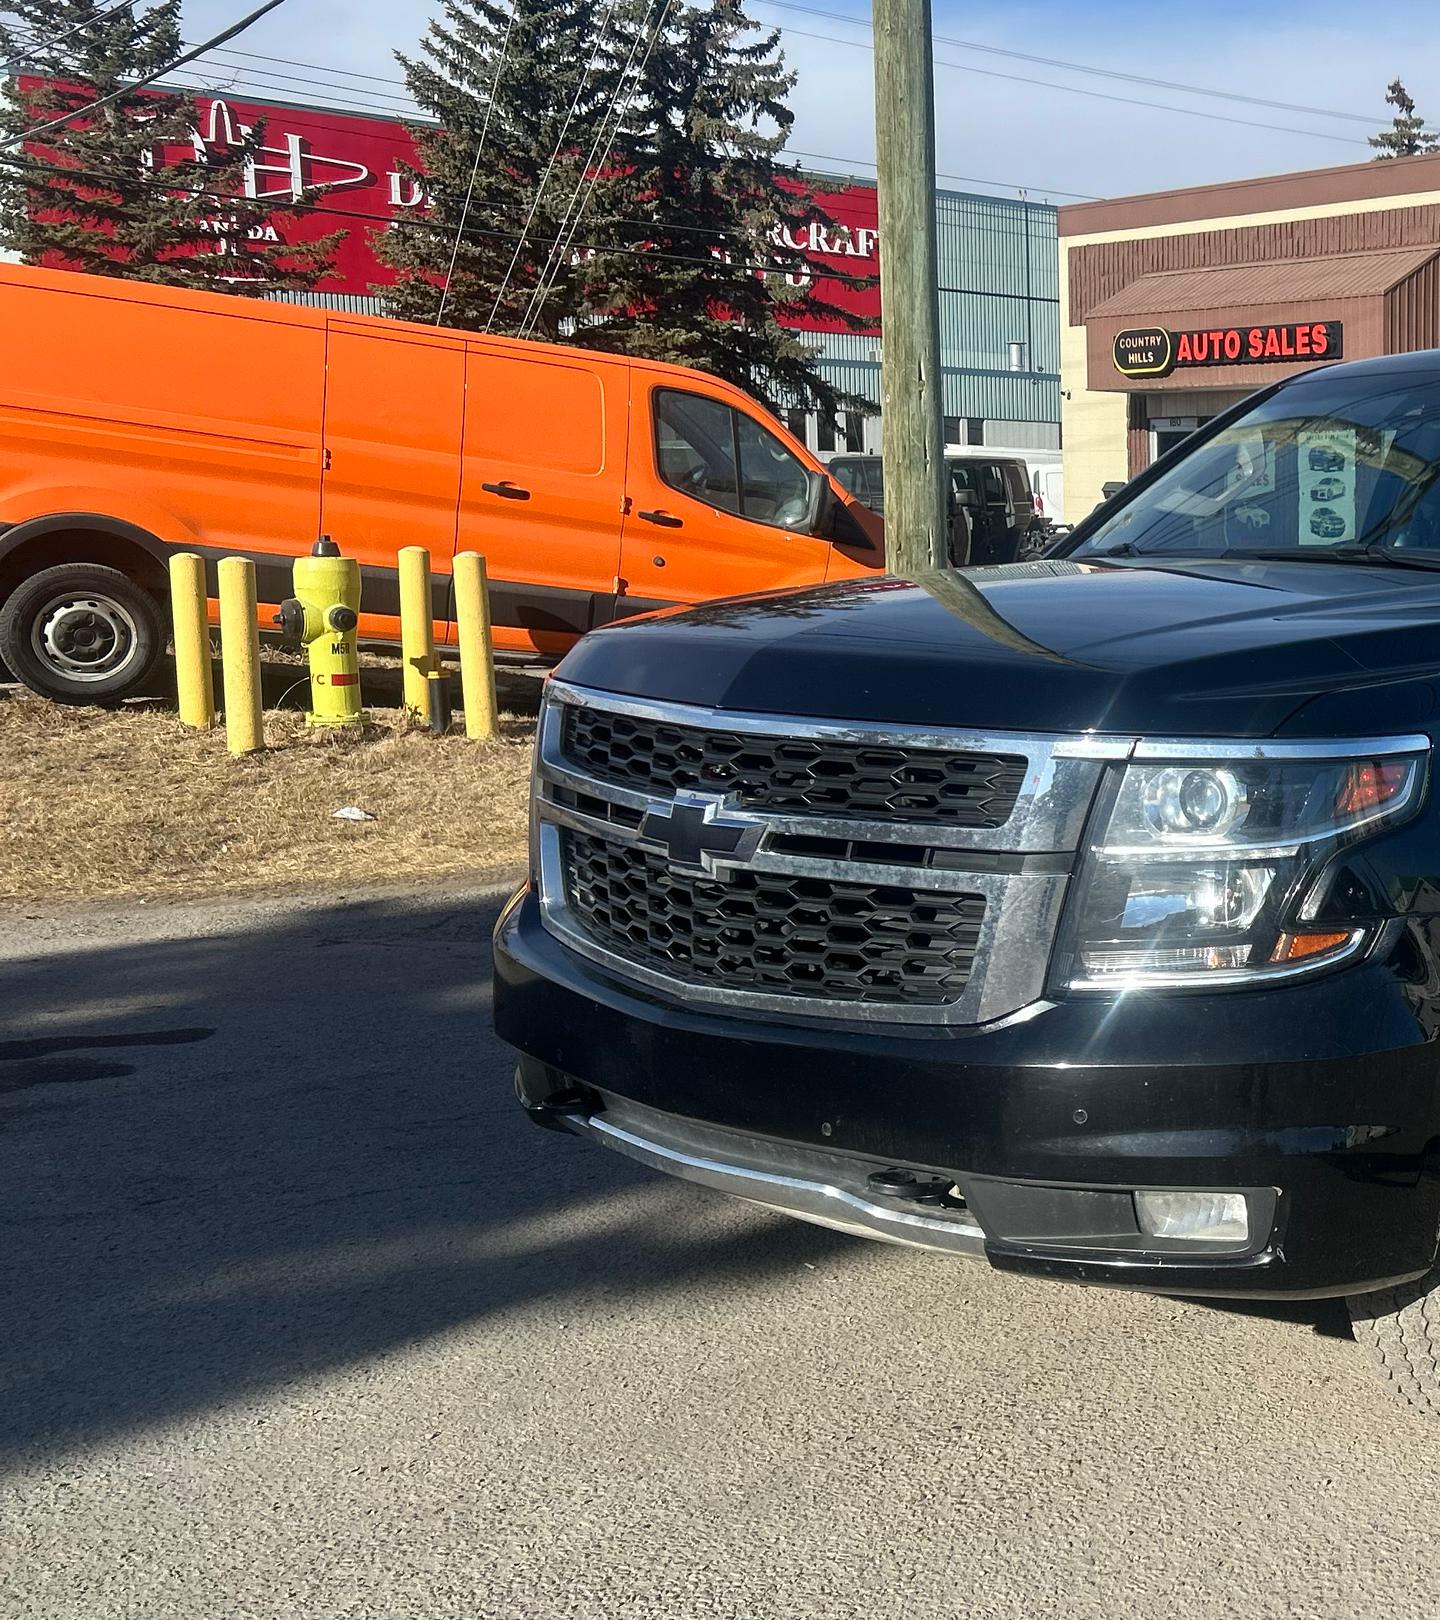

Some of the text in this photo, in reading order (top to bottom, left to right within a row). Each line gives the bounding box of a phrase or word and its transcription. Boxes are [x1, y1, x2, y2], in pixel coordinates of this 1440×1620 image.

[1119, 335, 1162, 349] COUNTRY
[1177, 324, 1329, 362] AUTO SALES
[1128, 351, 1154, 364] HILLS
